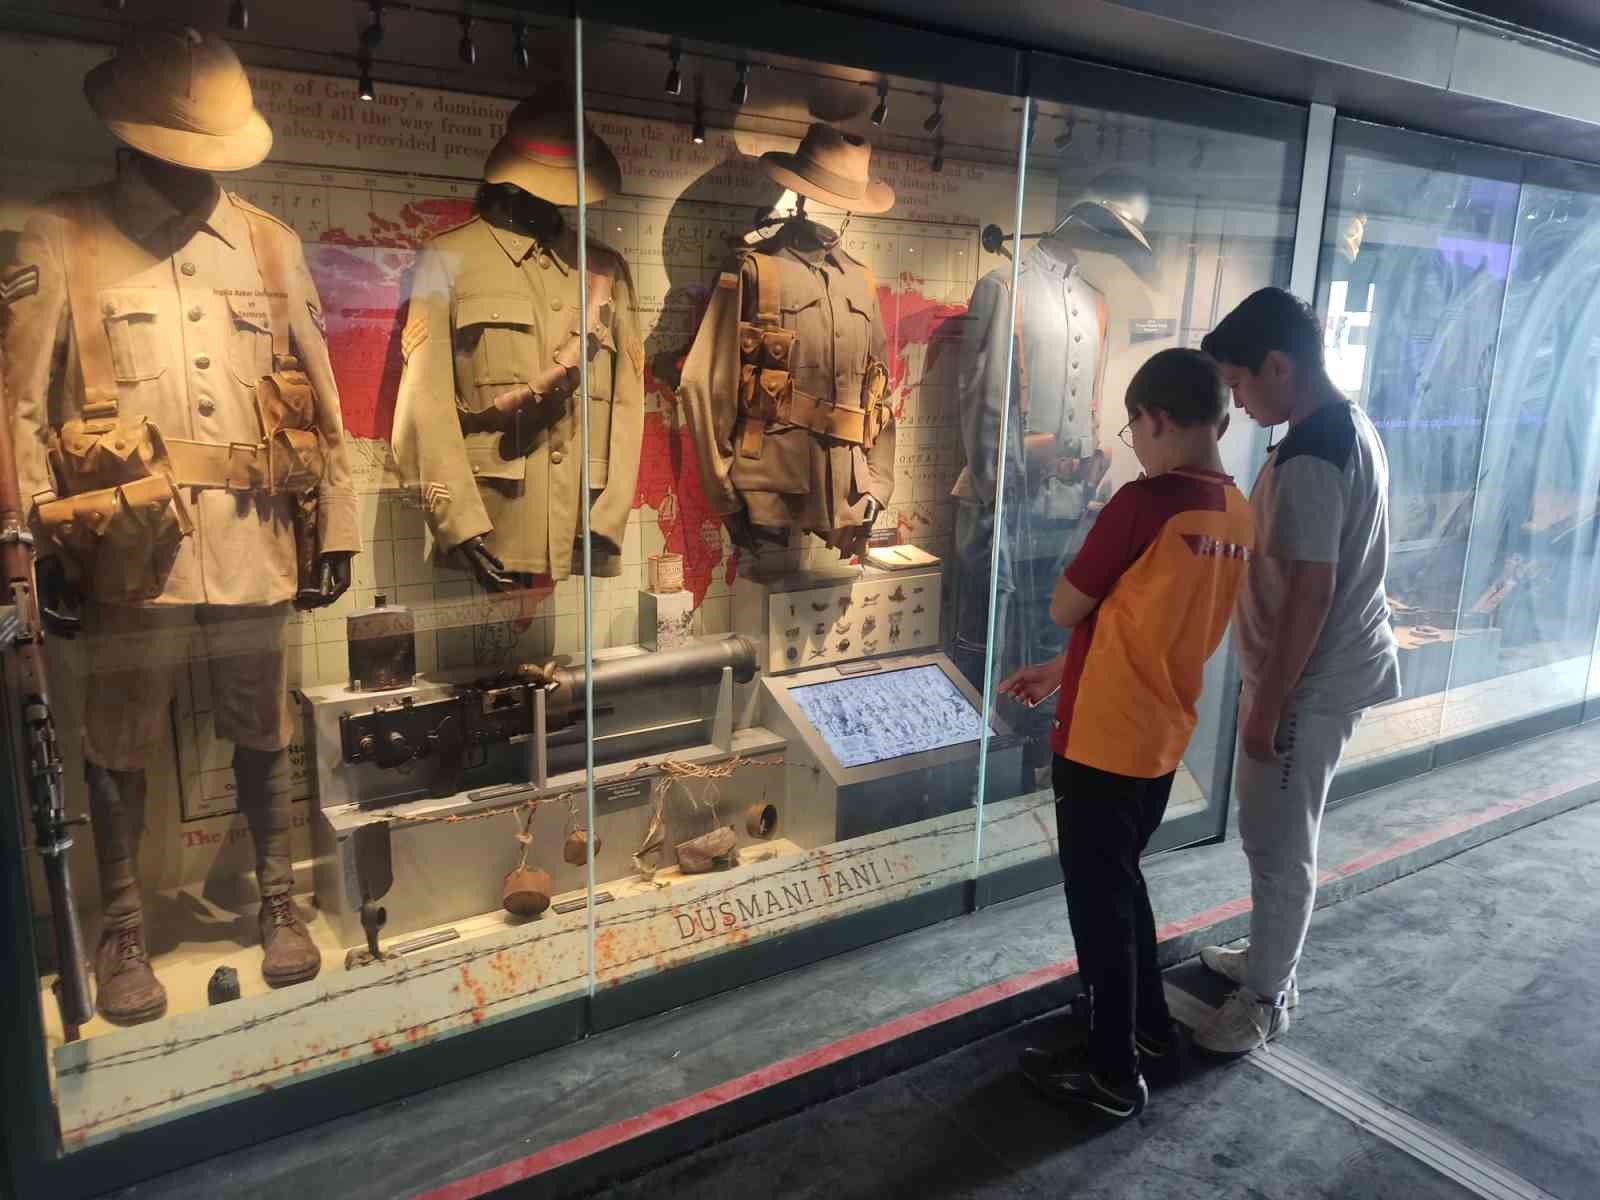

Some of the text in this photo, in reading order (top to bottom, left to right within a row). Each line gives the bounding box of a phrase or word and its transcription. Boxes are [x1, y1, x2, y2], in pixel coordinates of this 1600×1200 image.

[294, 80, 315, 97] of
[331, 104, 354, 121] all
[400, 117, 433, 138] way
[441, 116, 482, 137] from
[818, 861, 881, 897] TANI
